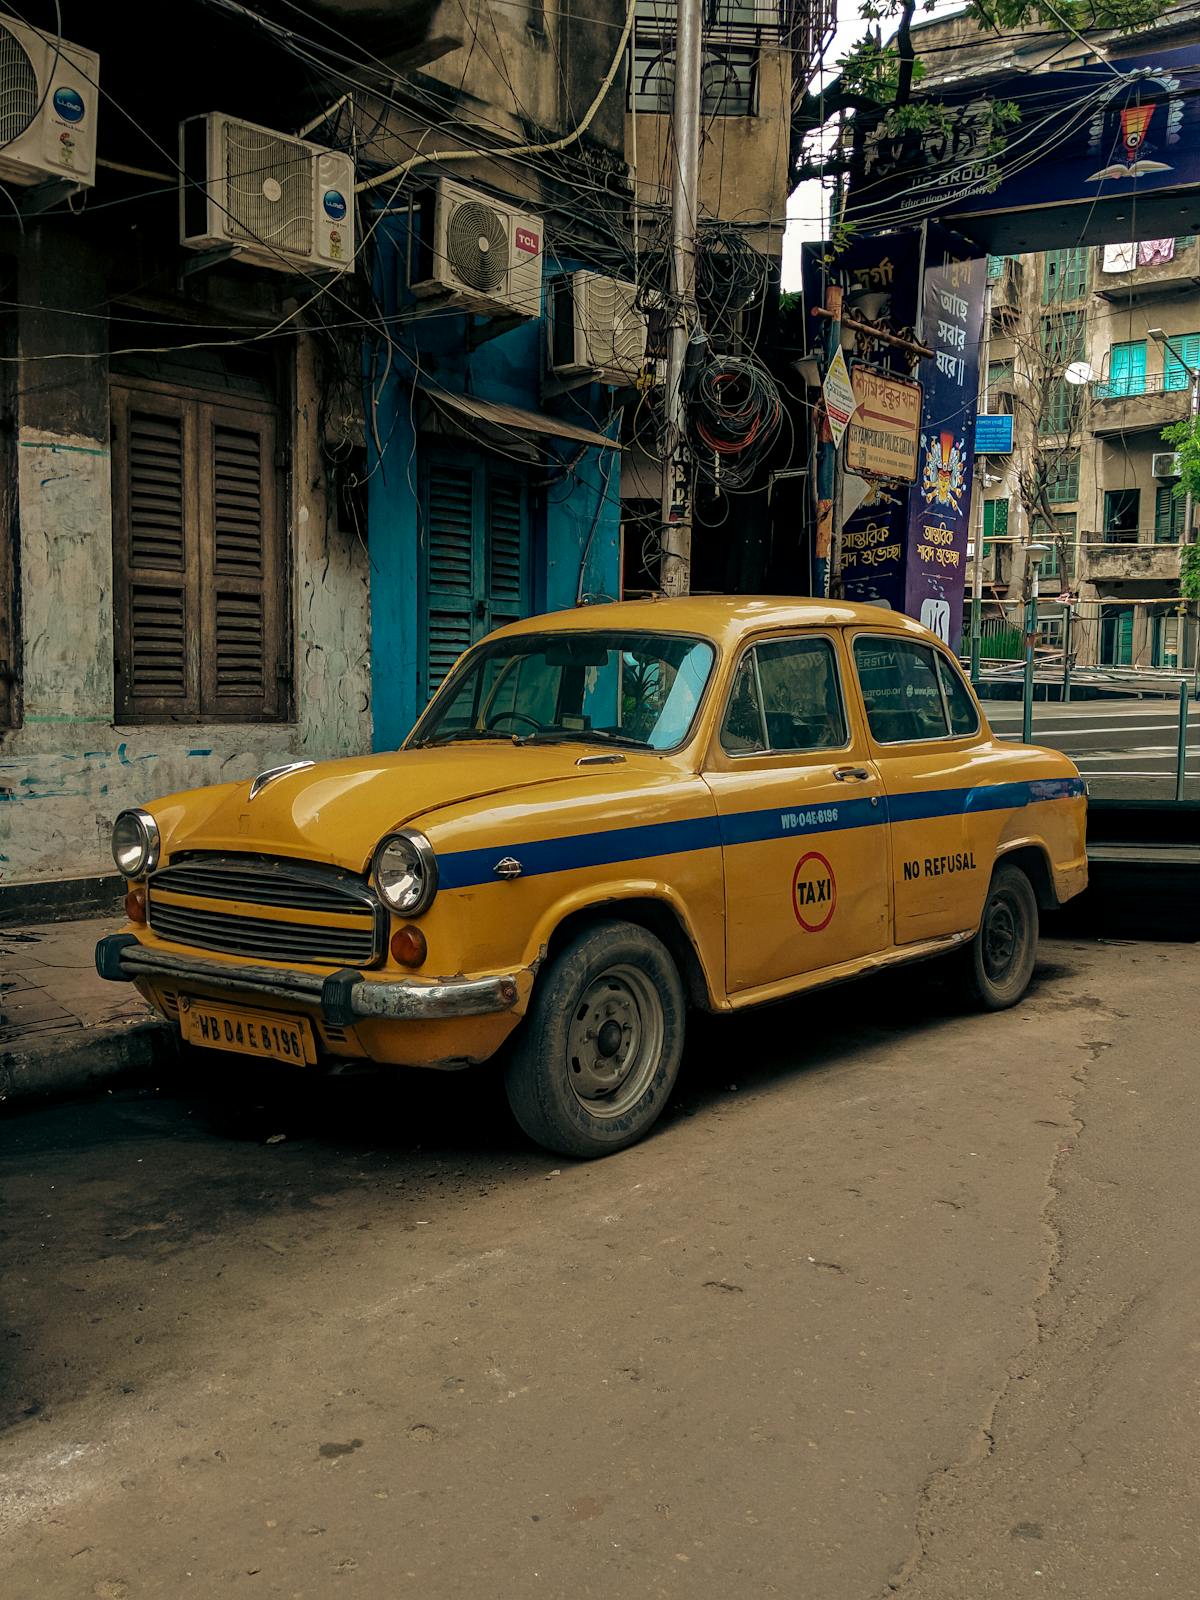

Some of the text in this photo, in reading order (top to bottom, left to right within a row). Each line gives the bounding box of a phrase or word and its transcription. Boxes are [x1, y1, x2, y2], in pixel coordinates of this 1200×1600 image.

[937, 163, 998, 185] GROUP
[518, 233, 537, 249] TCL
[941, 290, 969, 323] আছে
[937, 320, 967, 352] সবার
[885, 432, 899, 453] POLICE
[841, 522, 890, 549] আন্তরিক
[922, 521, 954, 546] আন্তরিক
[860, 543, 902, 566] শুভেচ্ছা
[917, 543, 960, 569] শারদ শুভেচ্ছা
[903, 852, 977, 881] NO REFUSAL
[797, 878, 832, 905] TAXI
